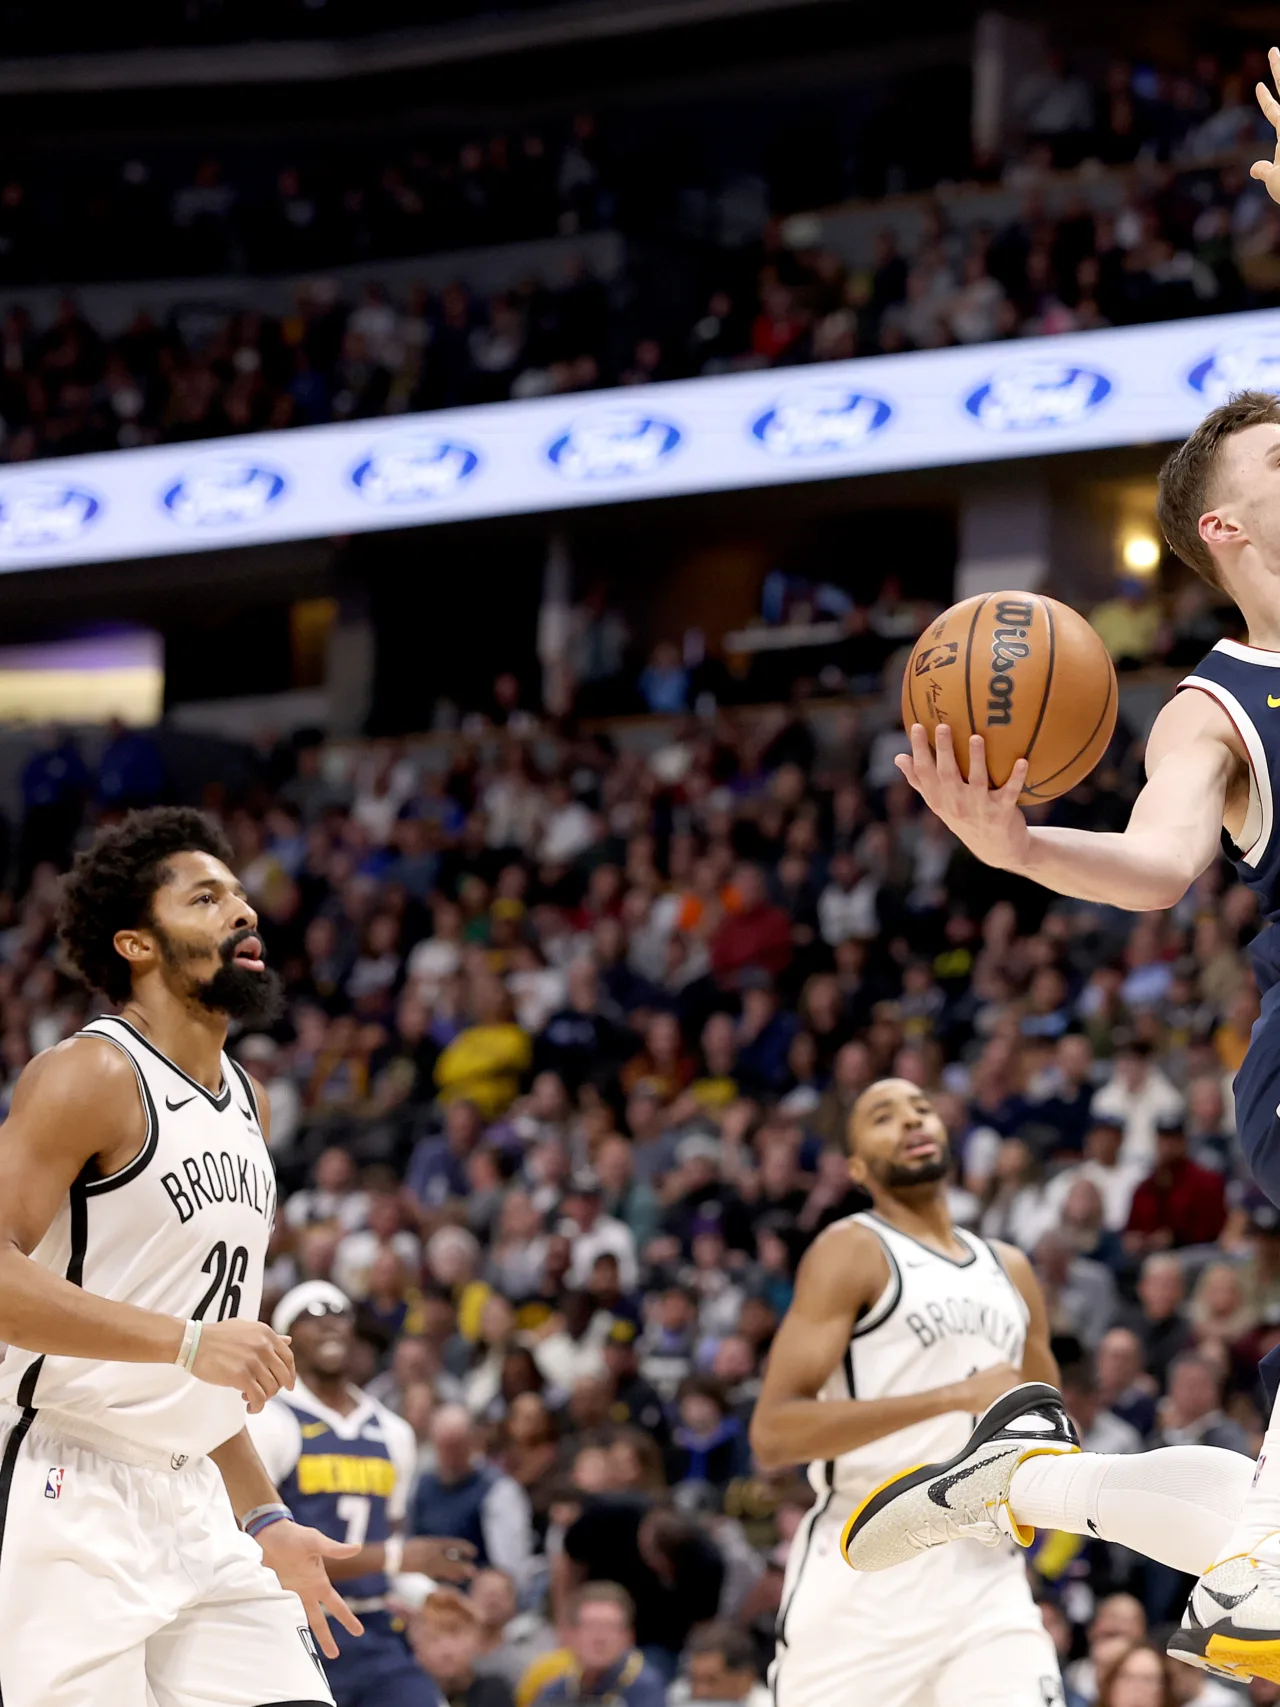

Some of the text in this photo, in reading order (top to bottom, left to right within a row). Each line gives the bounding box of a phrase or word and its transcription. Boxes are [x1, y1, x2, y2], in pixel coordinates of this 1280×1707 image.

[977, 362, 1100, 430] Ford
[986, 600, 1035, 727] Wilson
[192, 1240, 249, 1322] 26
